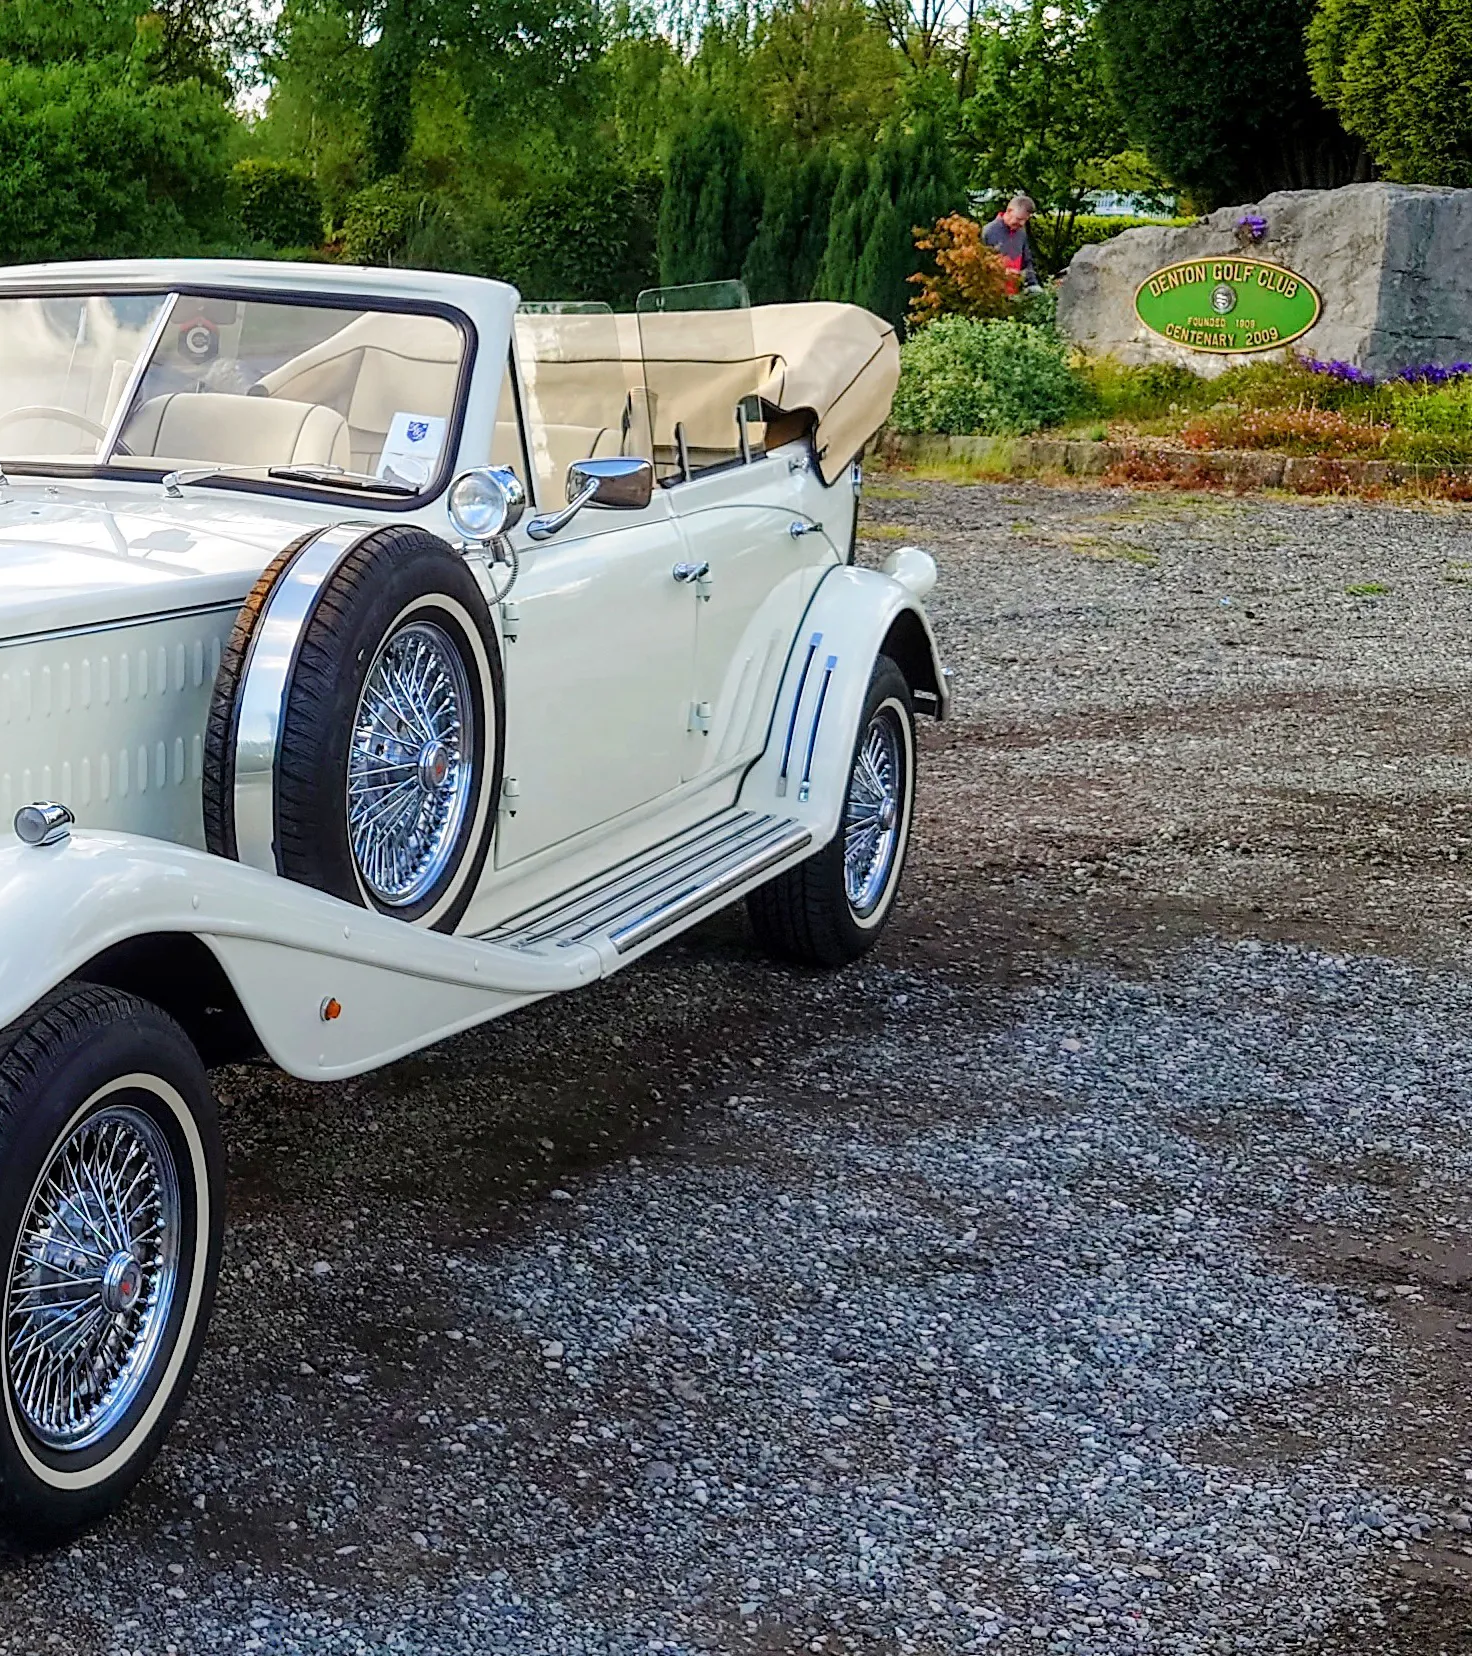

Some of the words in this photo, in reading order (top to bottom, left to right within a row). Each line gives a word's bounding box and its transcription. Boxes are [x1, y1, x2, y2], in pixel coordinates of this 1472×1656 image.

[1148, 264, 1206, 297] DENTON
[1212, 263, 1255, 282] GOLF
[1257, 269, 1299, 299] CLUB
[1187, 316, 1227, 328] FOUNDED
[1165, 323, 1236, 347] CENTENARY
[1245, 326, 1279, 346] 2009
